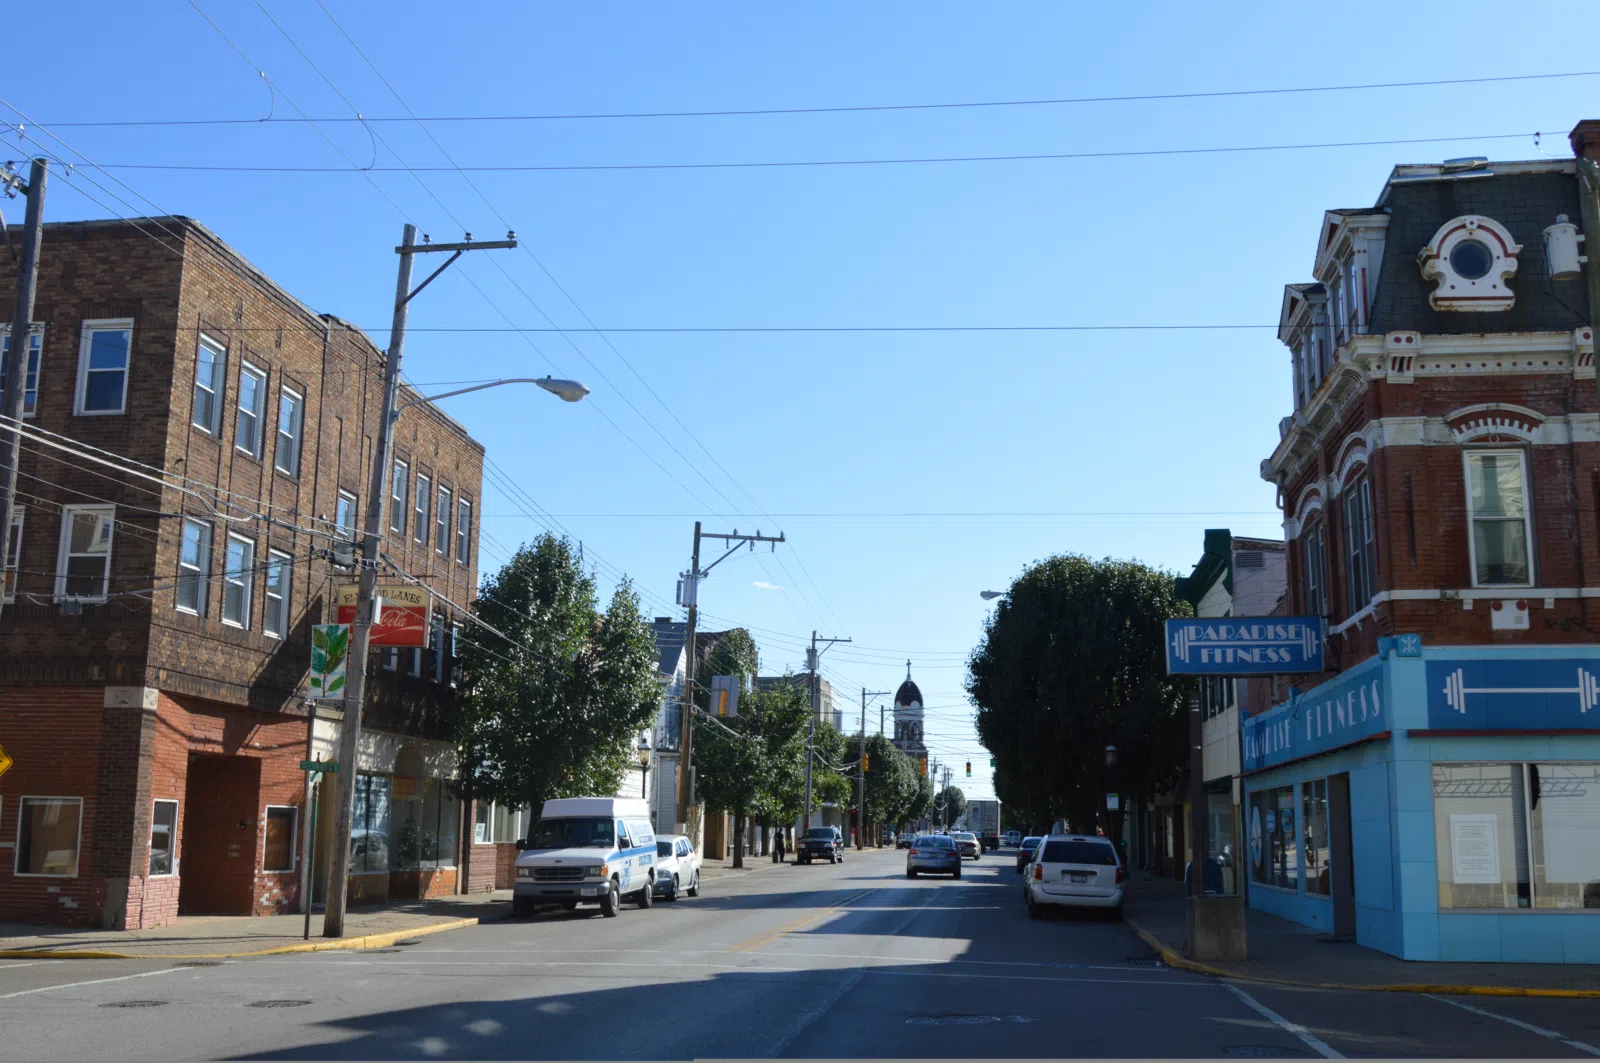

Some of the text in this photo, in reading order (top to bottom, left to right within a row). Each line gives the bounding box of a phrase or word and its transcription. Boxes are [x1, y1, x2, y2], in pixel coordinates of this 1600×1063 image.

[343, 589, 422, 605] ELOD LANES
[379, 609, 409, 627] Cola
[1188, 624, 1303, 641] PARADISE
[1200, 646, 1292, 664] FITNESS
[1306, 679, 1380, 741] FITNESS
